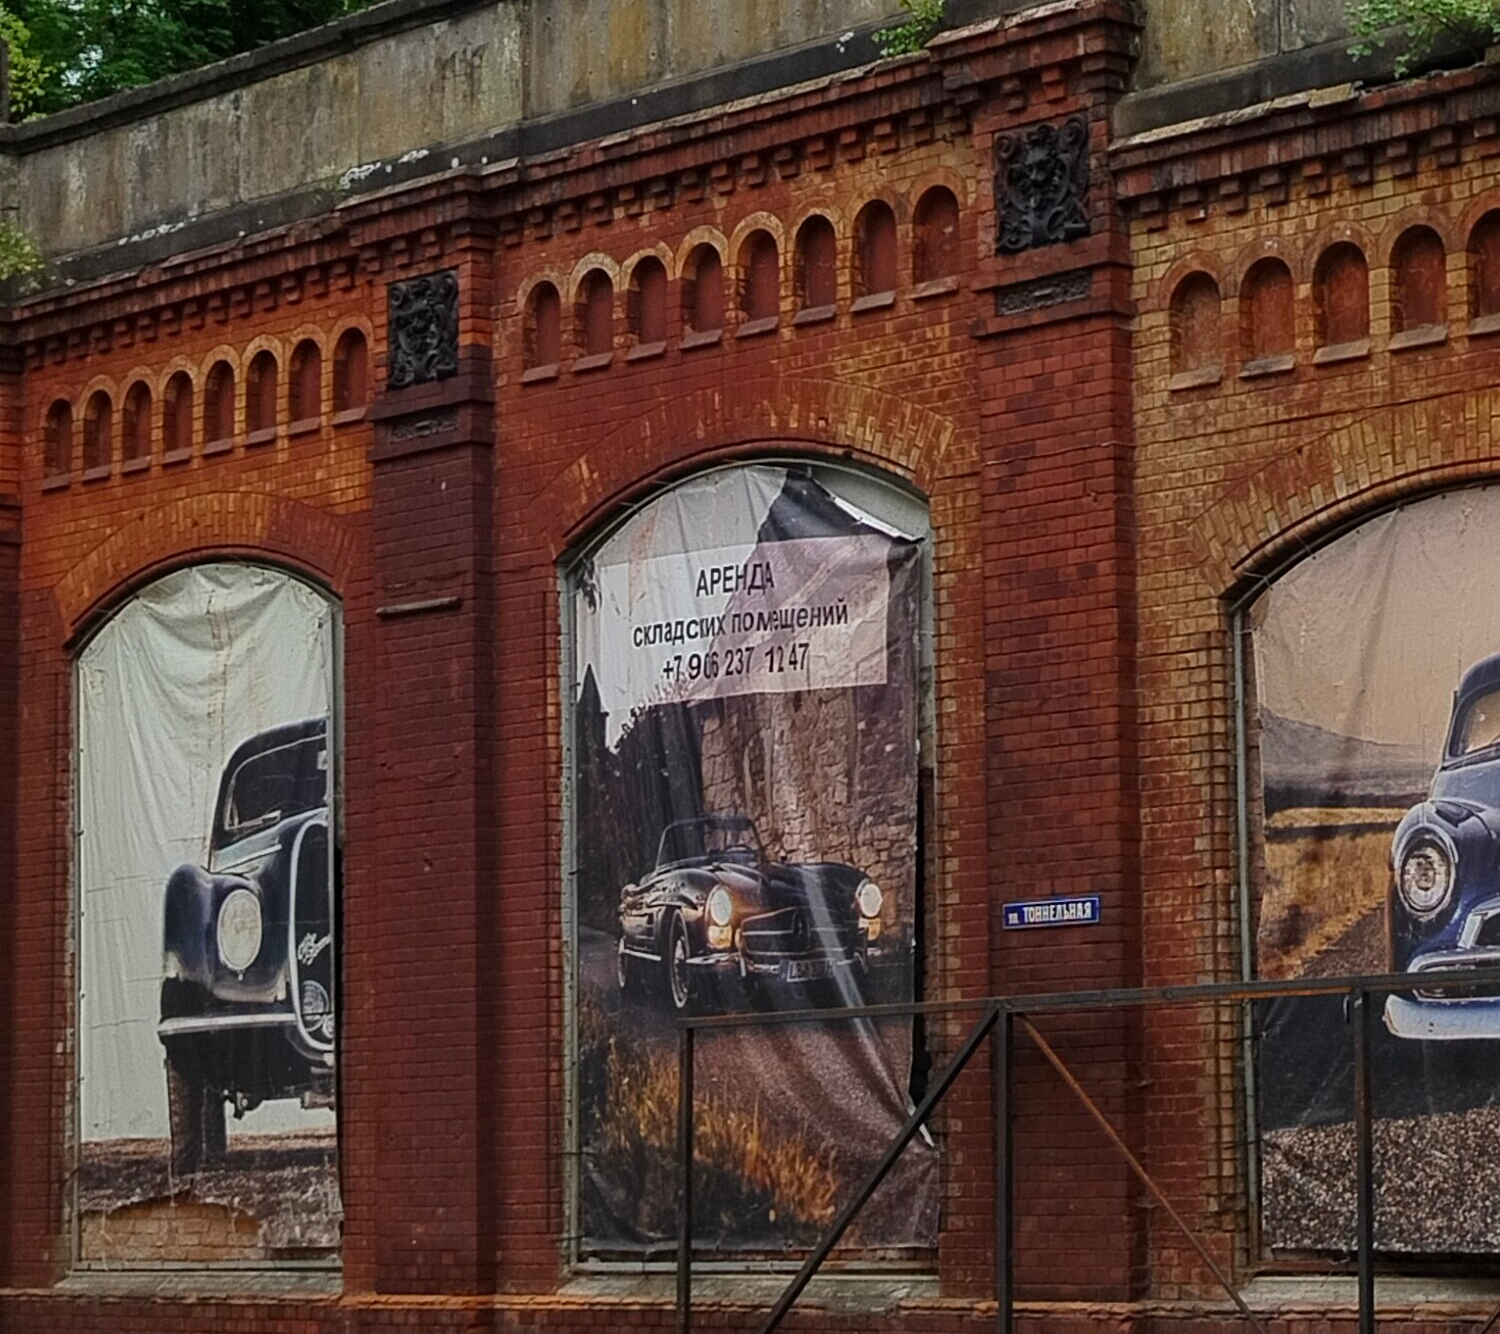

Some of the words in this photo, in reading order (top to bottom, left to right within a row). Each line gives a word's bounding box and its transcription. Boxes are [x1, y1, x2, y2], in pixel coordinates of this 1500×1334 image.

[695, 561, 775, 598] АРЕНДА
[662, 654, 683, 682] +7
[724, 646, 755, 677] 237
[1022, 901, 1092, 923] ТОННЕЛЬНАЯ
